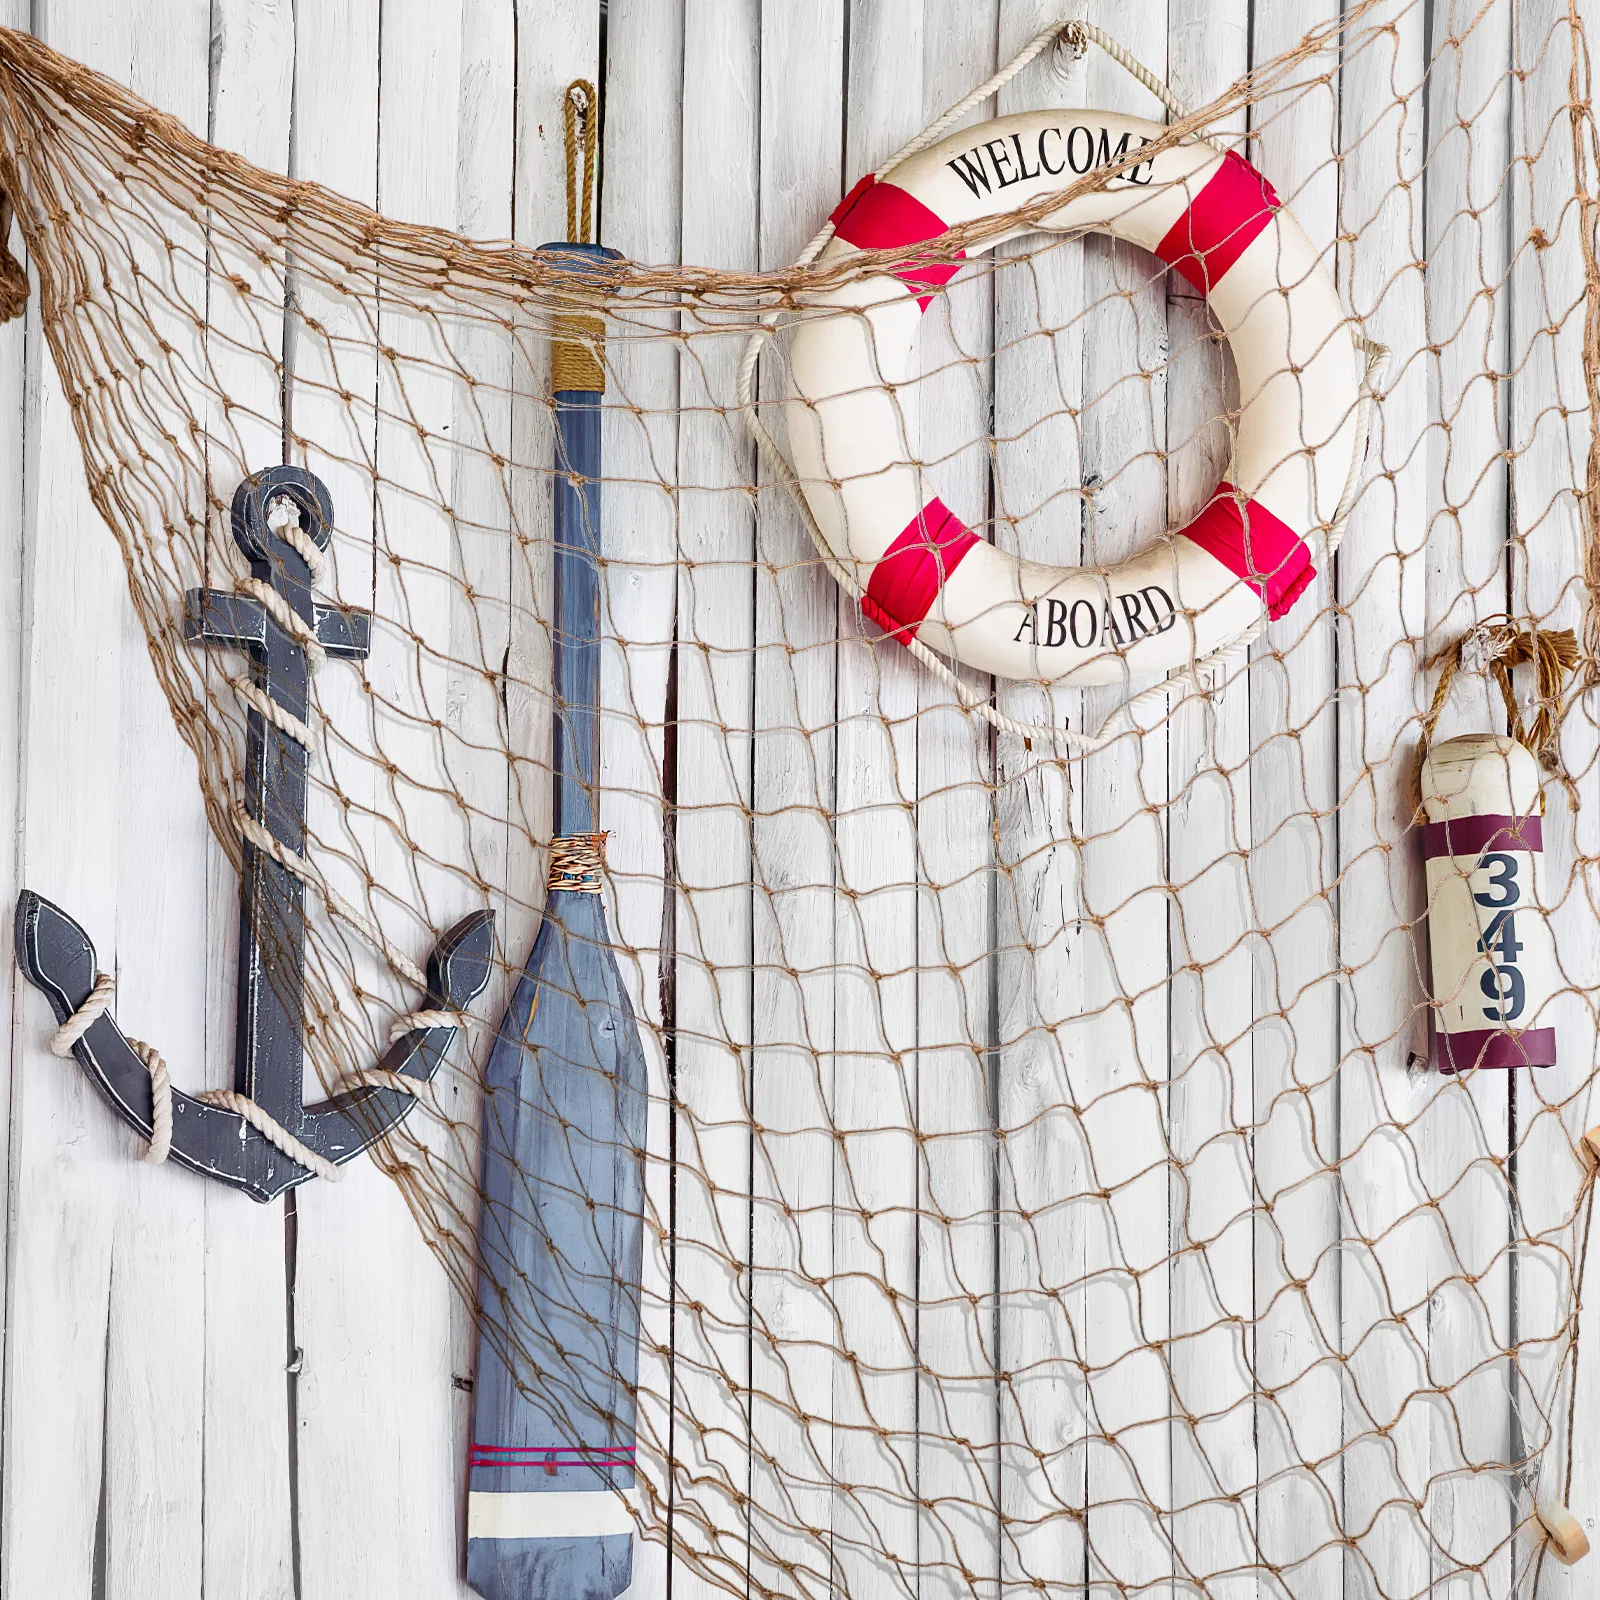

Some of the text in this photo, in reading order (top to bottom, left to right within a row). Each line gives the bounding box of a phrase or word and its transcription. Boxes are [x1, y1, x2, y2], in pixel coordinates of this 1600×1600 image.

[946, 126, 1154, 200] WELCOME
[1013, 585, 1176, 648] ABOARD
[1474, 853, 1526, 1022] 349
